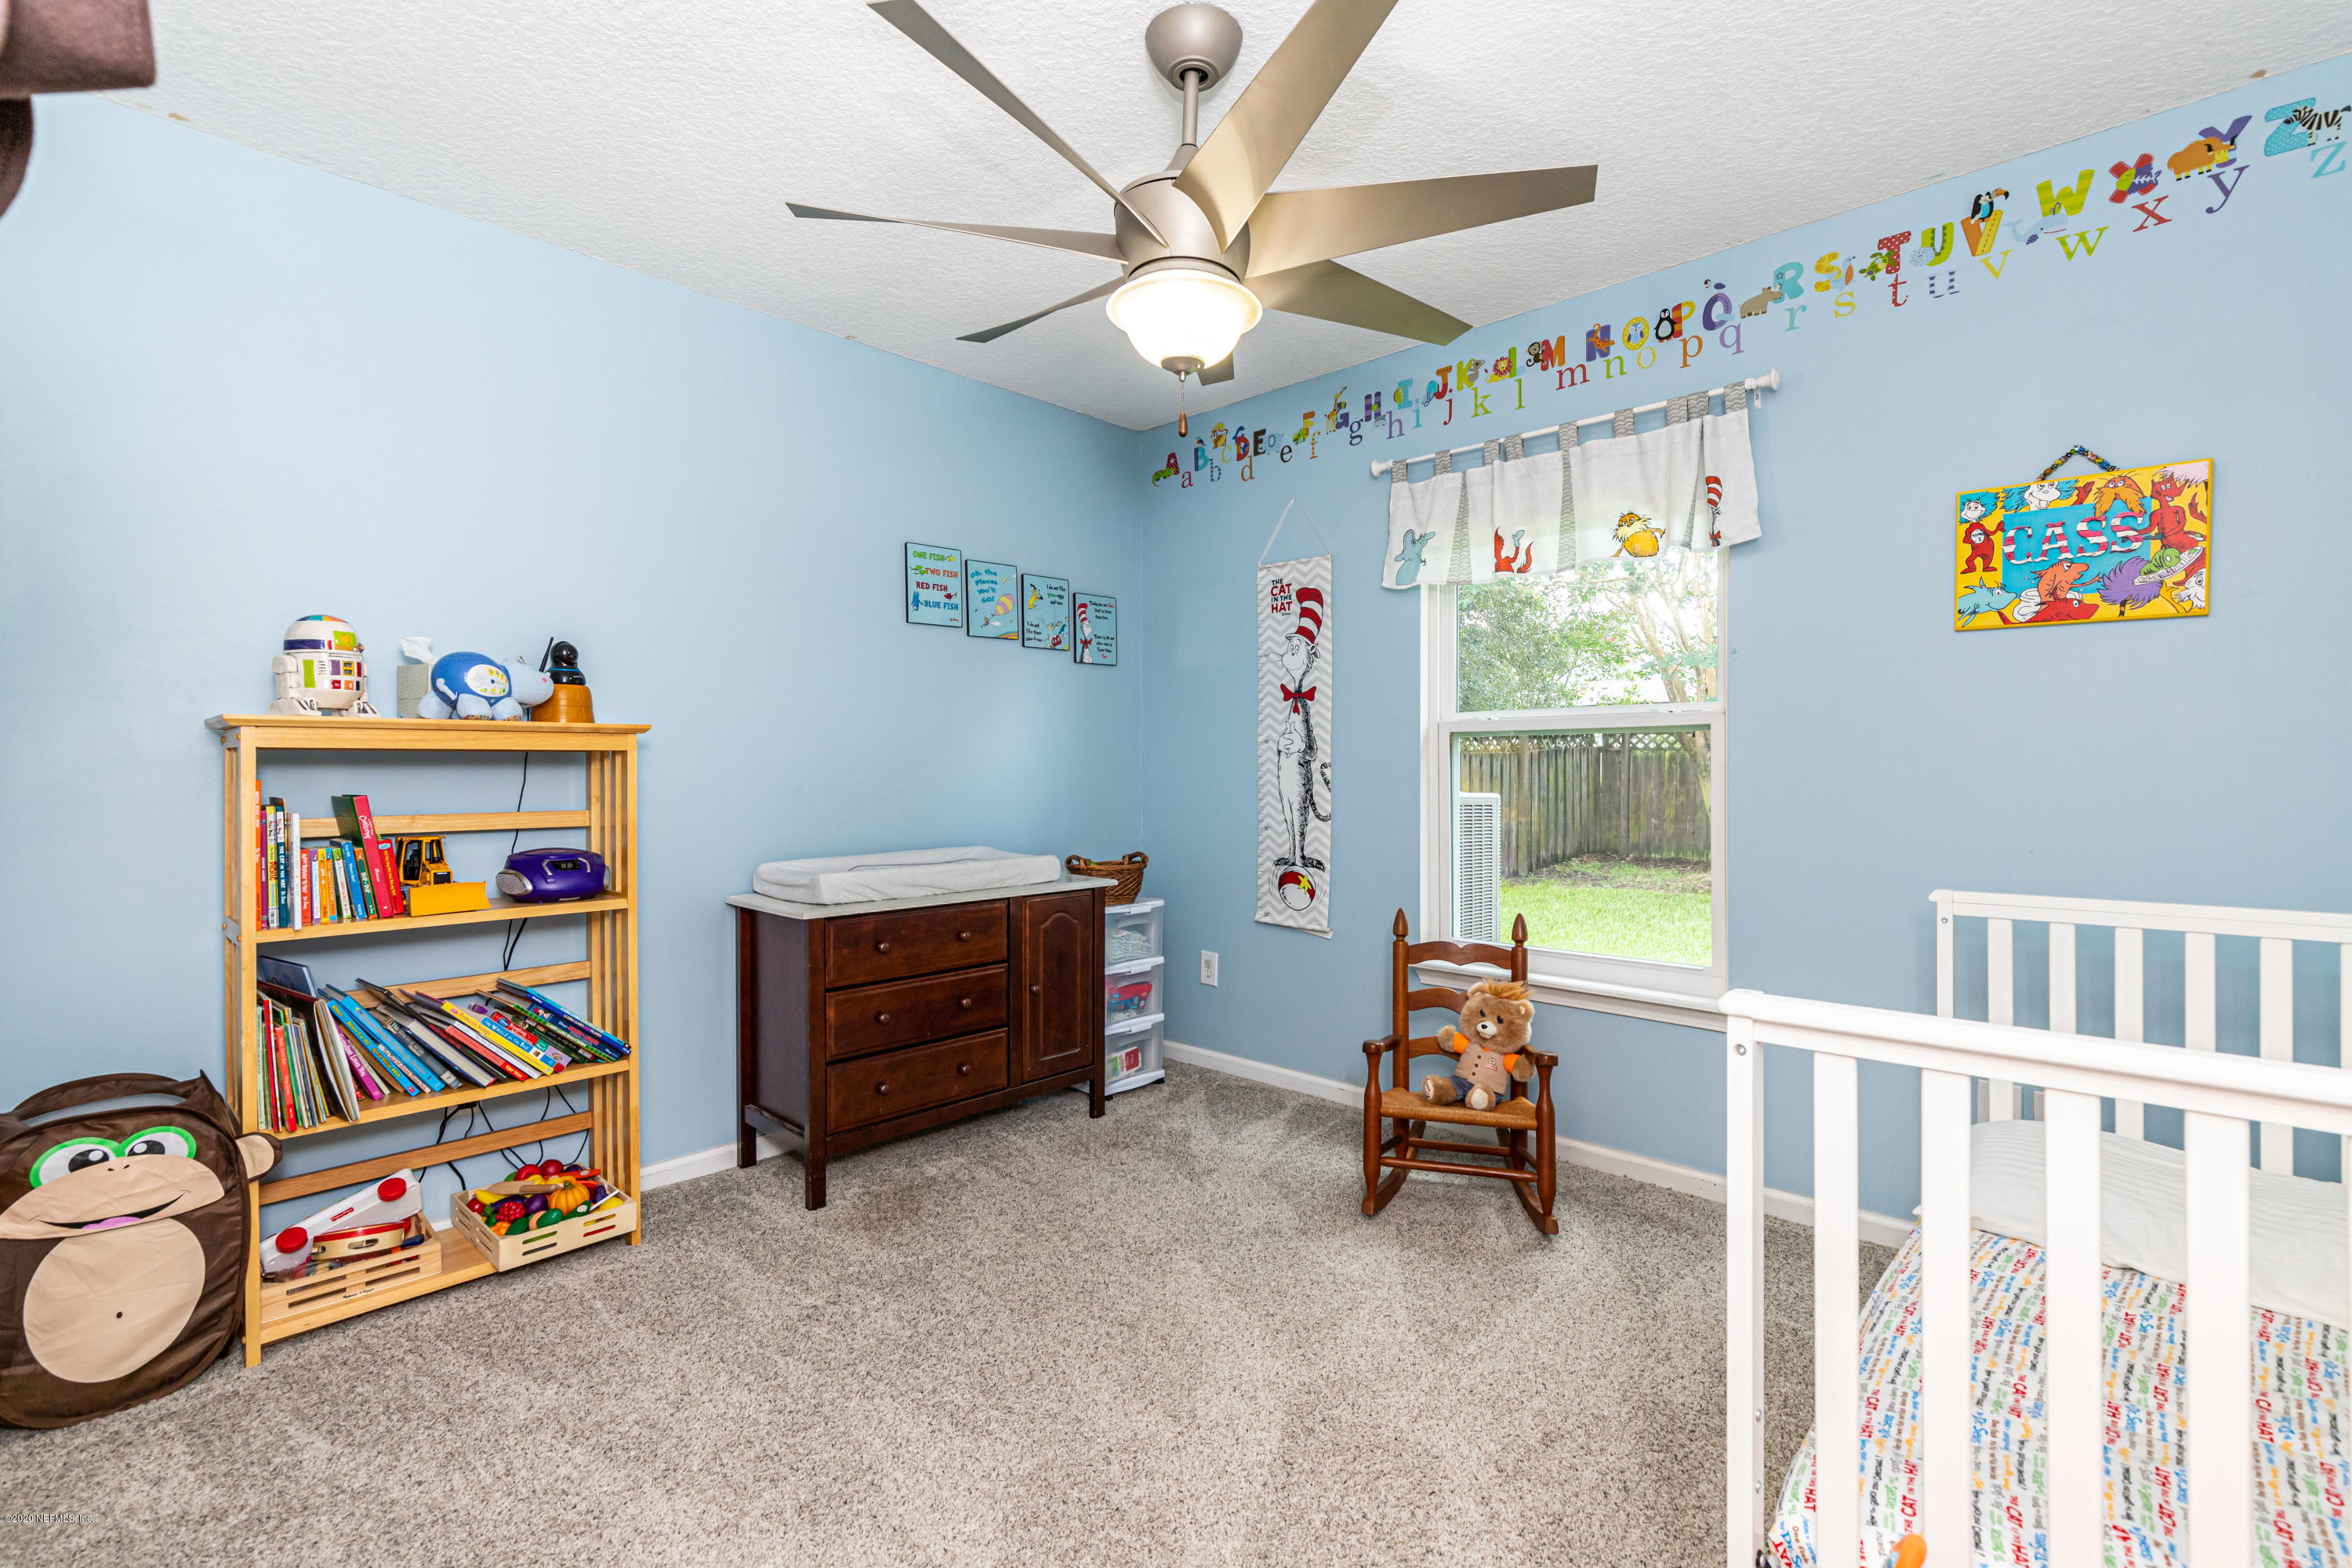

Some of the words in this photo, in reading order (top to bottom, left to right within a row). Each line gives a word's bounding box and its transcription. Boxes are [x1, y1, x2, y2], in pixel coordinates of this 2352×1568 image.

[1194, 448, 1209, 471] B
[1253, 428, 1267, 456] E
[1302, 412, 1315, 437] F
[1365, 392, 1381, 423] H
[1436, 365, 1452, 399] J
[1541, 336, 1565, 371] M
[1585, 325, 1611, 361] N
[1623, 317, 1650, 350] O
[1671, 300, 1696, 339] P
[1773, 261, 1804, 303] R
[1814, 252, 1842, 292] S
[1878, 230, 1911, 274] T
[1961, 210, 2003, 257] V
[2036, 169, 2095, 218] W
[2264, 97, 2316, 157] Z
[1181, 471, 1194, 488] a
[1210, 459, 1221, 482] b
[1221, 445, 1232, 463] c
[1241, 458, 1254, 481] d
[1281, 445, 1292, 463] e
[1309, 431, 1321, 459] f
[1349, 418, 1363, 446] g
[1386, 411, 1405, 440] h
[1414, 397, 1422, 427] i
[1443, 389, 1453, 426] j
[1472, 387, 1491, 418] k
[1556, 364, 1590, 390] m
[1606, 355, 1627, 379] n
[1637, 347, 1656, 369] o
[1679, 333, 1703, 368] p
[1720, 323, 1744, 354] q
[1784, 304, 1806, 331] r
[1835, 291, 1856, 318] s
[1888, 274, 1908, 307] t
[1928, 270, 1960, 299] u
[1979, 249, 2012, 278] v
[2056, 226, 2109, 262] w
[2132, 195, 2172, 233] x
[2205, 165, 2249, 214] y
[2310, 141, 2347, 179] z
[2002, 511, 2146, 565] CASS
[913, 550, 927, 560] ONE
[929, 553, 945, 561] FISH
[925, 567, 941, 576] TWO
[942, 569, 958, 578] FISH
[916, 581, 931, 590] RED
[932, 583, 948, 592] FISH
[1271, 583, 1292, 597] CAT
[924, 600, 942, 609] BLUE
[943, 602, 958, 611] FISH
[1272, 601, 1292, 613] HAT
[269, 862, 278, 880] PICNIC
[459, 1012, 477, 1026] Princess
[477, 1024, 492, 1036] Songs
[510, 1022, 528, 1036] Reading
[491, 1024, 508, 1037] WHEELS
[520, 1042, 529, 1051] BUS
[350, 1054, 361, 1068] Loves
[358, 1066, 368, 1077] You
[1904, 1304, 1916, 1317] CAT
[1981, 1316, 1996, 1330] HAT
[2123, 1311, 2137, 1326] HAT
[1894, 1323, 1907, 1337] HAT
[2118, 1331, 2132, 1345] CAT
[2156, 1363, 2170, 1378] HAT
[2306, 1358, 2320, 1372] HAT
[2013, 1383, 2027, 1397] CAT
[2307, 1378, 2322, 1392] CAT
[2153, 1386, 2169, 1403] CAT
[1865, 1396, 1878, 1411] CAT
[1860, 1424, 1872, 1439] HAT
[2258, 1421, 2274, 1443] HAT
[2320, 1461, 2337, 1477] HAT
[1907, 1476, 1915, 1486] THE
[2154, 1467, 2171, 1490] HAT
[1804, 1488, 1817, 1512] HAT
[2009, 1495, 2020, 1506] THE
[2324, 1486, 2344, 1508] CAT
[1902, 1495, 1915, 1516] CAT
[2006, 1505, 2024, 1526] CAT
[2156, 1503, 2176, 1527] CAT
[1904, 1519, 1914, 1533] THE
[2274, 1518, 2293, 1542] CAT
[2012, 1544, 2030, 1568] HAT
